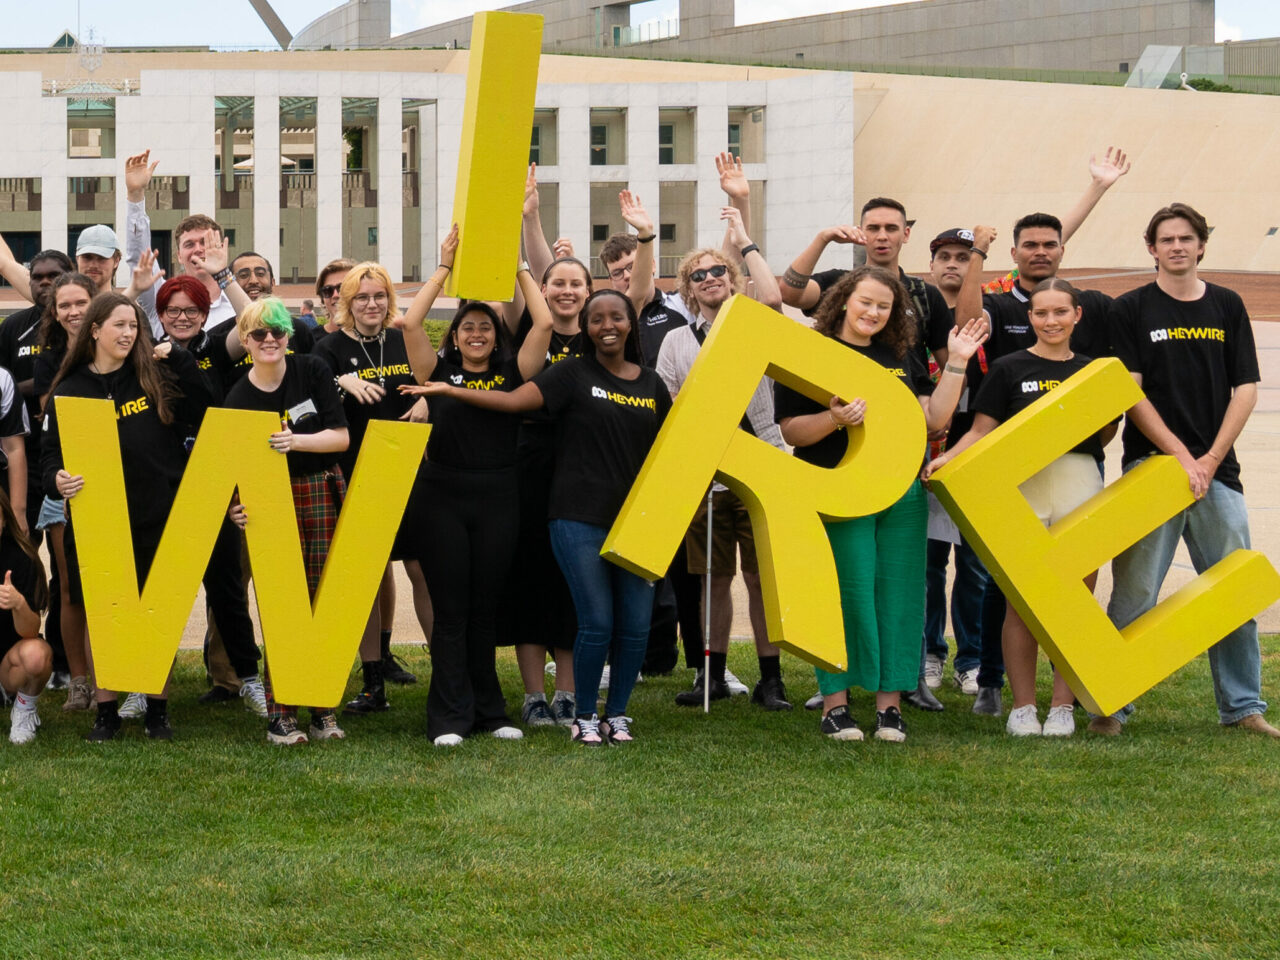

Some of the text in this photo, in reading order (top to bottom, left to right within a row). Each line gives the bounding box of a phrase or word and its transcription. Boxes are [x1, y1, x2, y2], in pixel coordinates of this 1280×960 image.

[1167, 327, 1226, 343] HEYWIRE
[357, 363, 411, 381] HEYWIRE
[607, 391, 657, 414] HEYWIR
